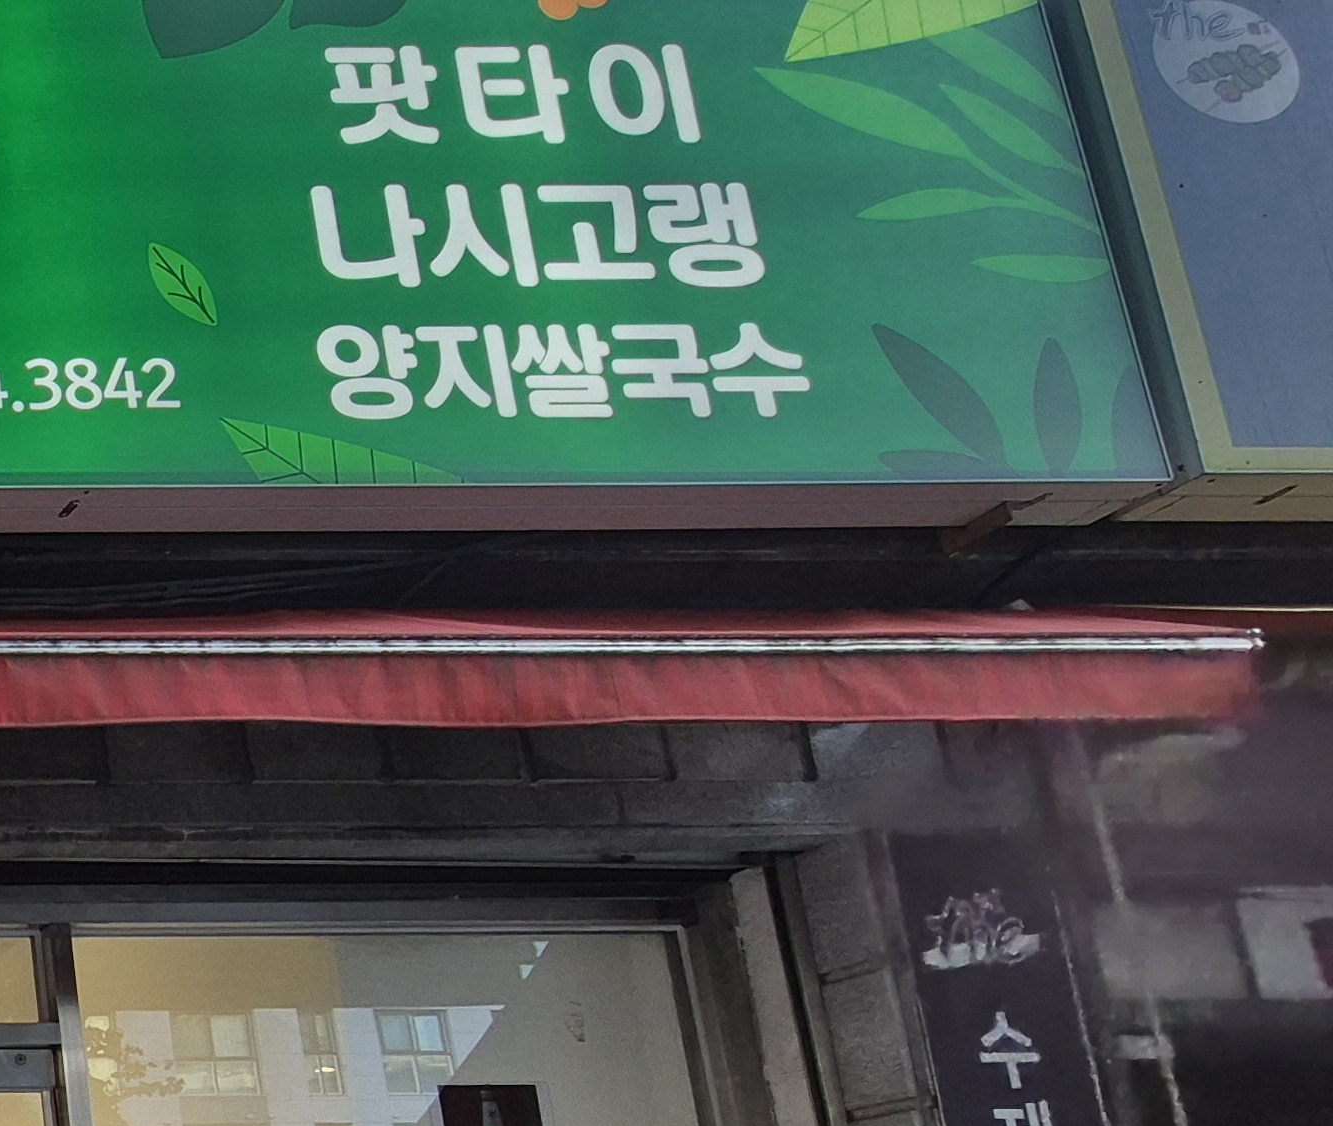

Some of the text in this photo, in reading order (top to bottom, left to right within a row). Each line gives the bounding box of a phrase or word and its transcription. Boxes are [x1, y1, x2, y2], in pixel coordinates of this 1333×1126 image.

[323, 43, 702, 145] 팟타이
[310, 182, 766, 288] 나시고랭
[316, 322, 811, 420] 양지쌀국수
